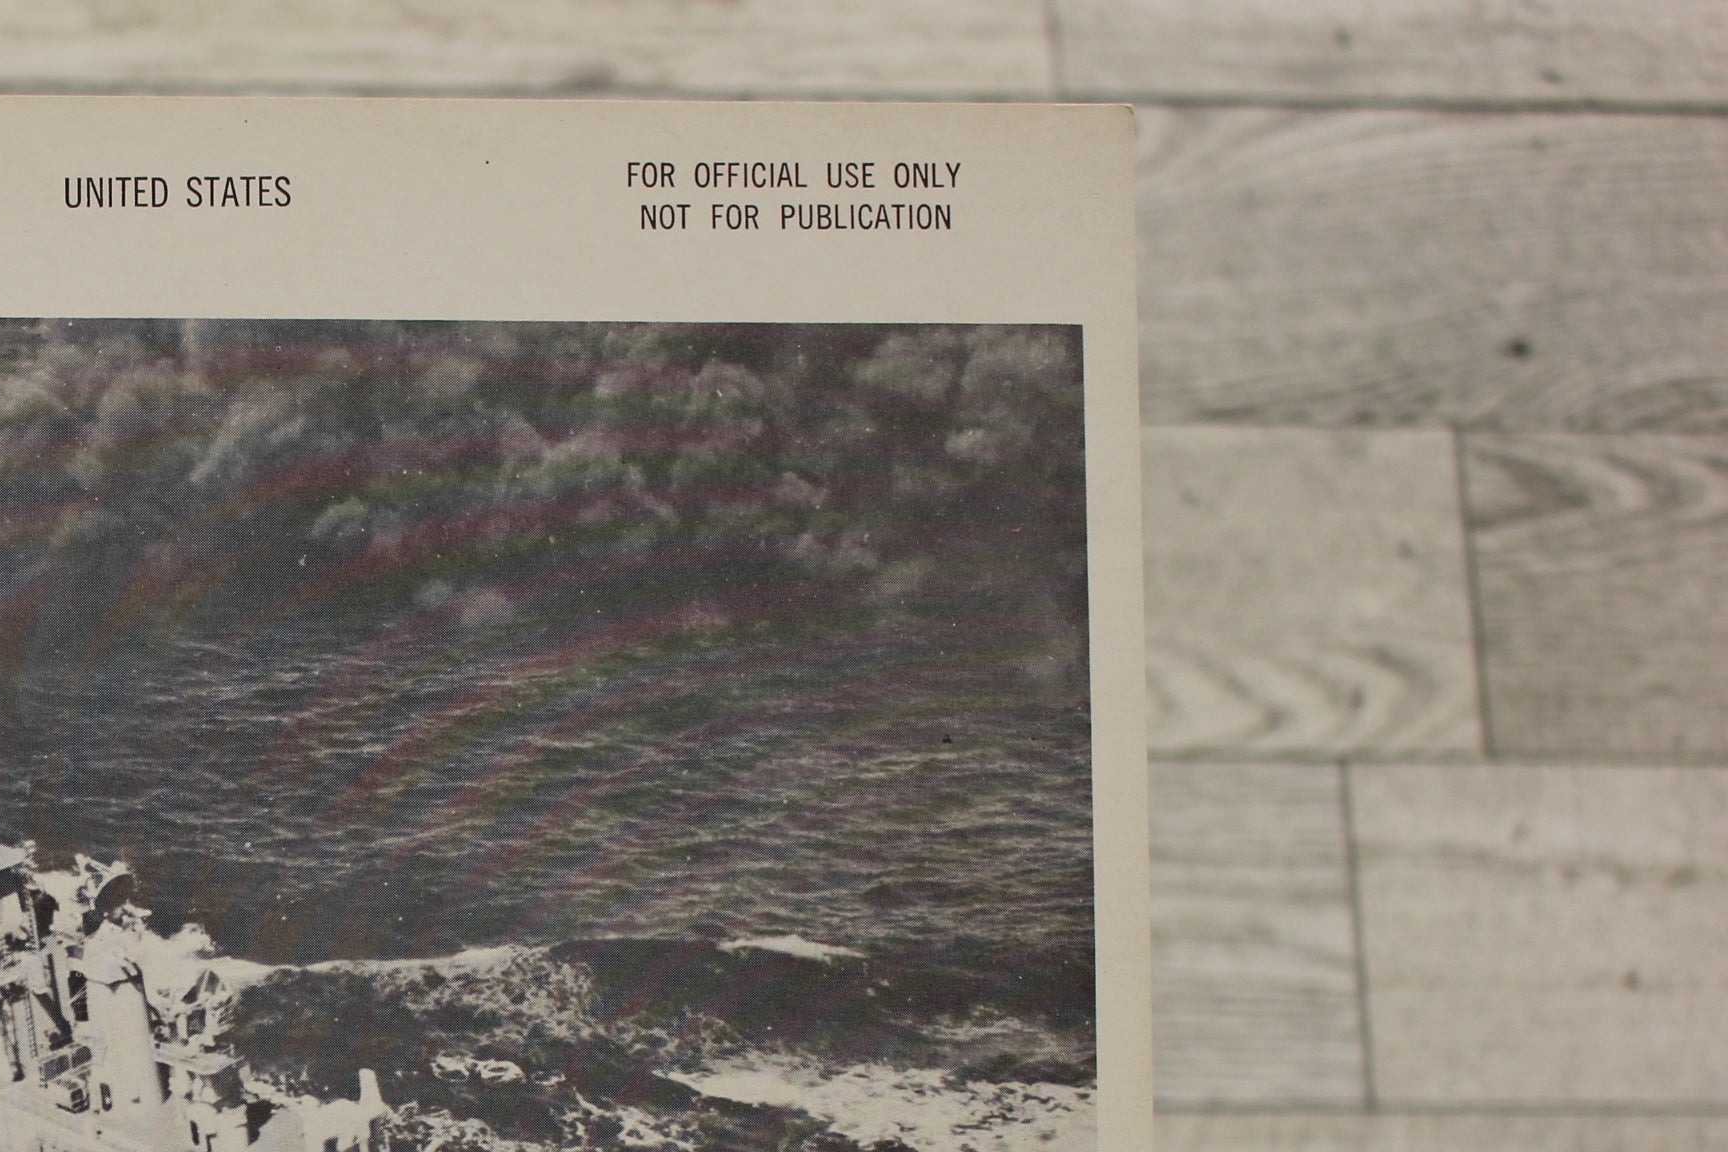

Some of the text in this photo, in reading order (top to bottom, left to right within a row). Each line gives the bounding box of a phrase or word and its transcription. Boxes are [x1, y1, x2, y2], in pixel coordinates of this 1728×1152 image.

[626, 161, 962, 190] FOR OFFICIAL USE ONLY
[63, 175, 292, 209] UNITED STATES
[639, 203, 952, 232] NOT FOR PUBLICATION
